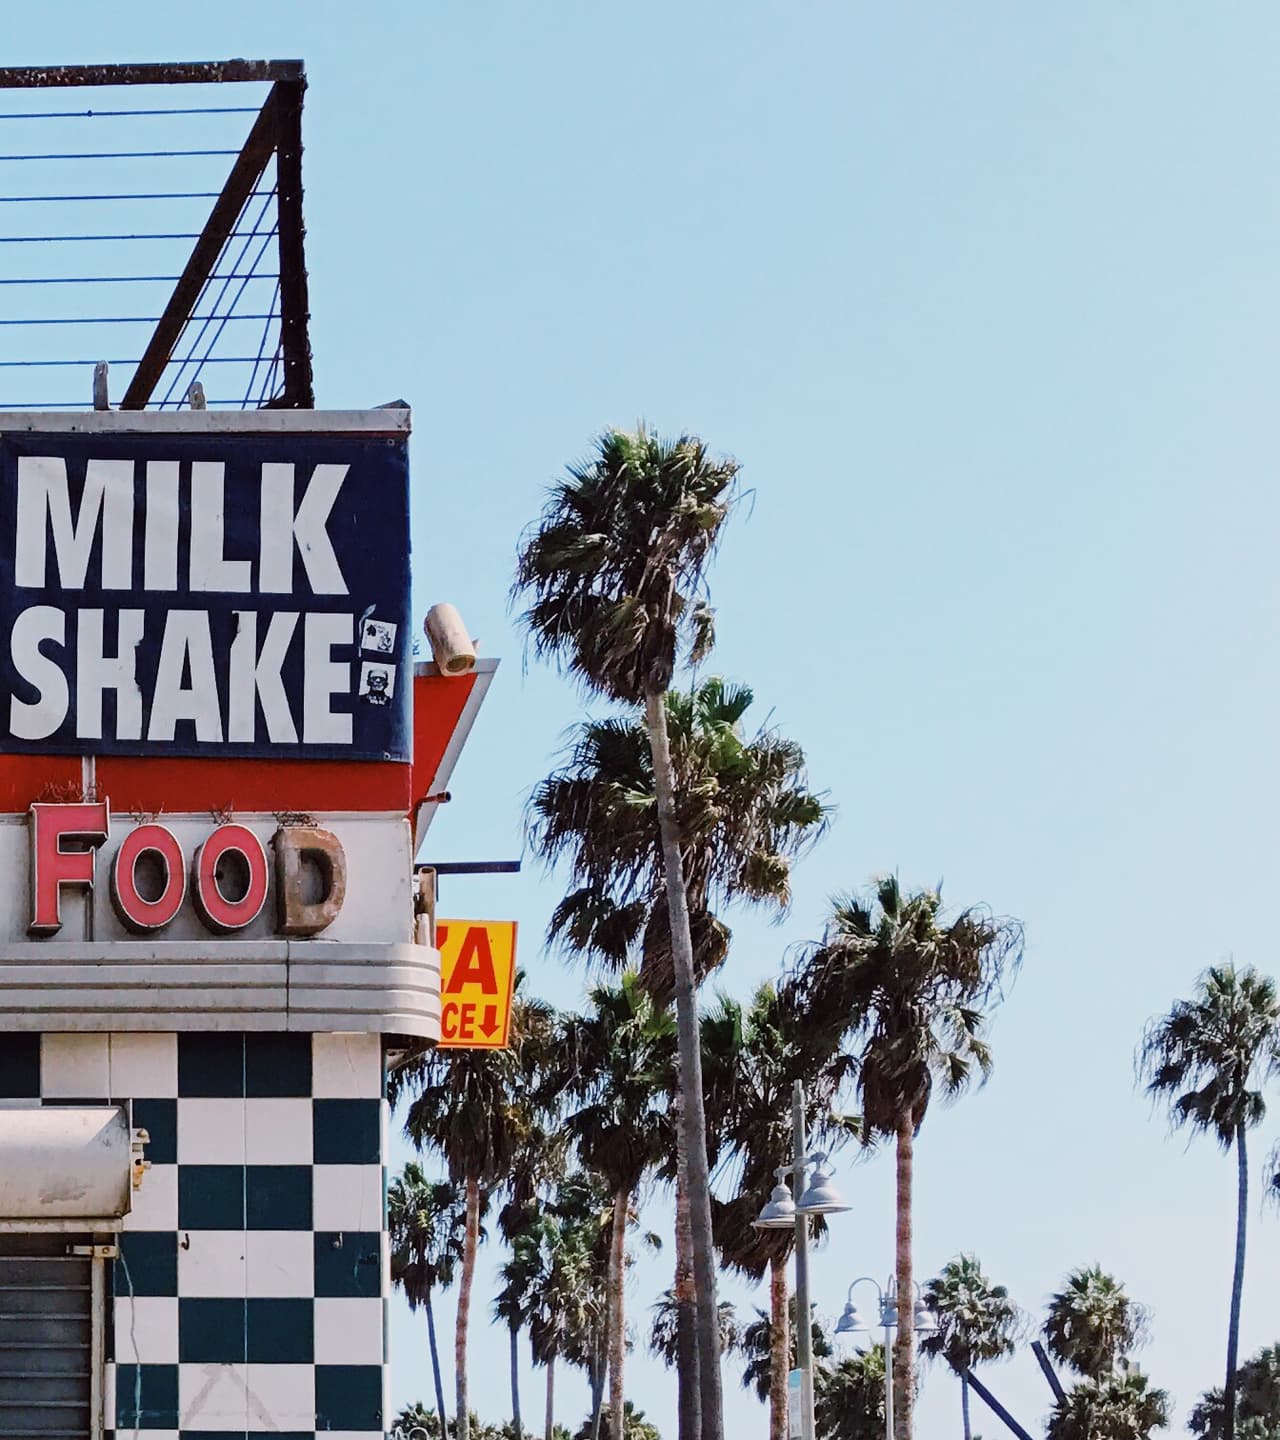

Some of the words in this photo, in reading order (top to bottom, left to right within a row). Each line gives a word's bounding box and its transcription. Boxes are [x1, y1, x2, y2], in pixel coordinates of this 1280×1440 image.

[14, 455, 352, 596] MILK
[8, 604, 355, 746] SHAKE
[28, 795, 348, 938] FOOD
